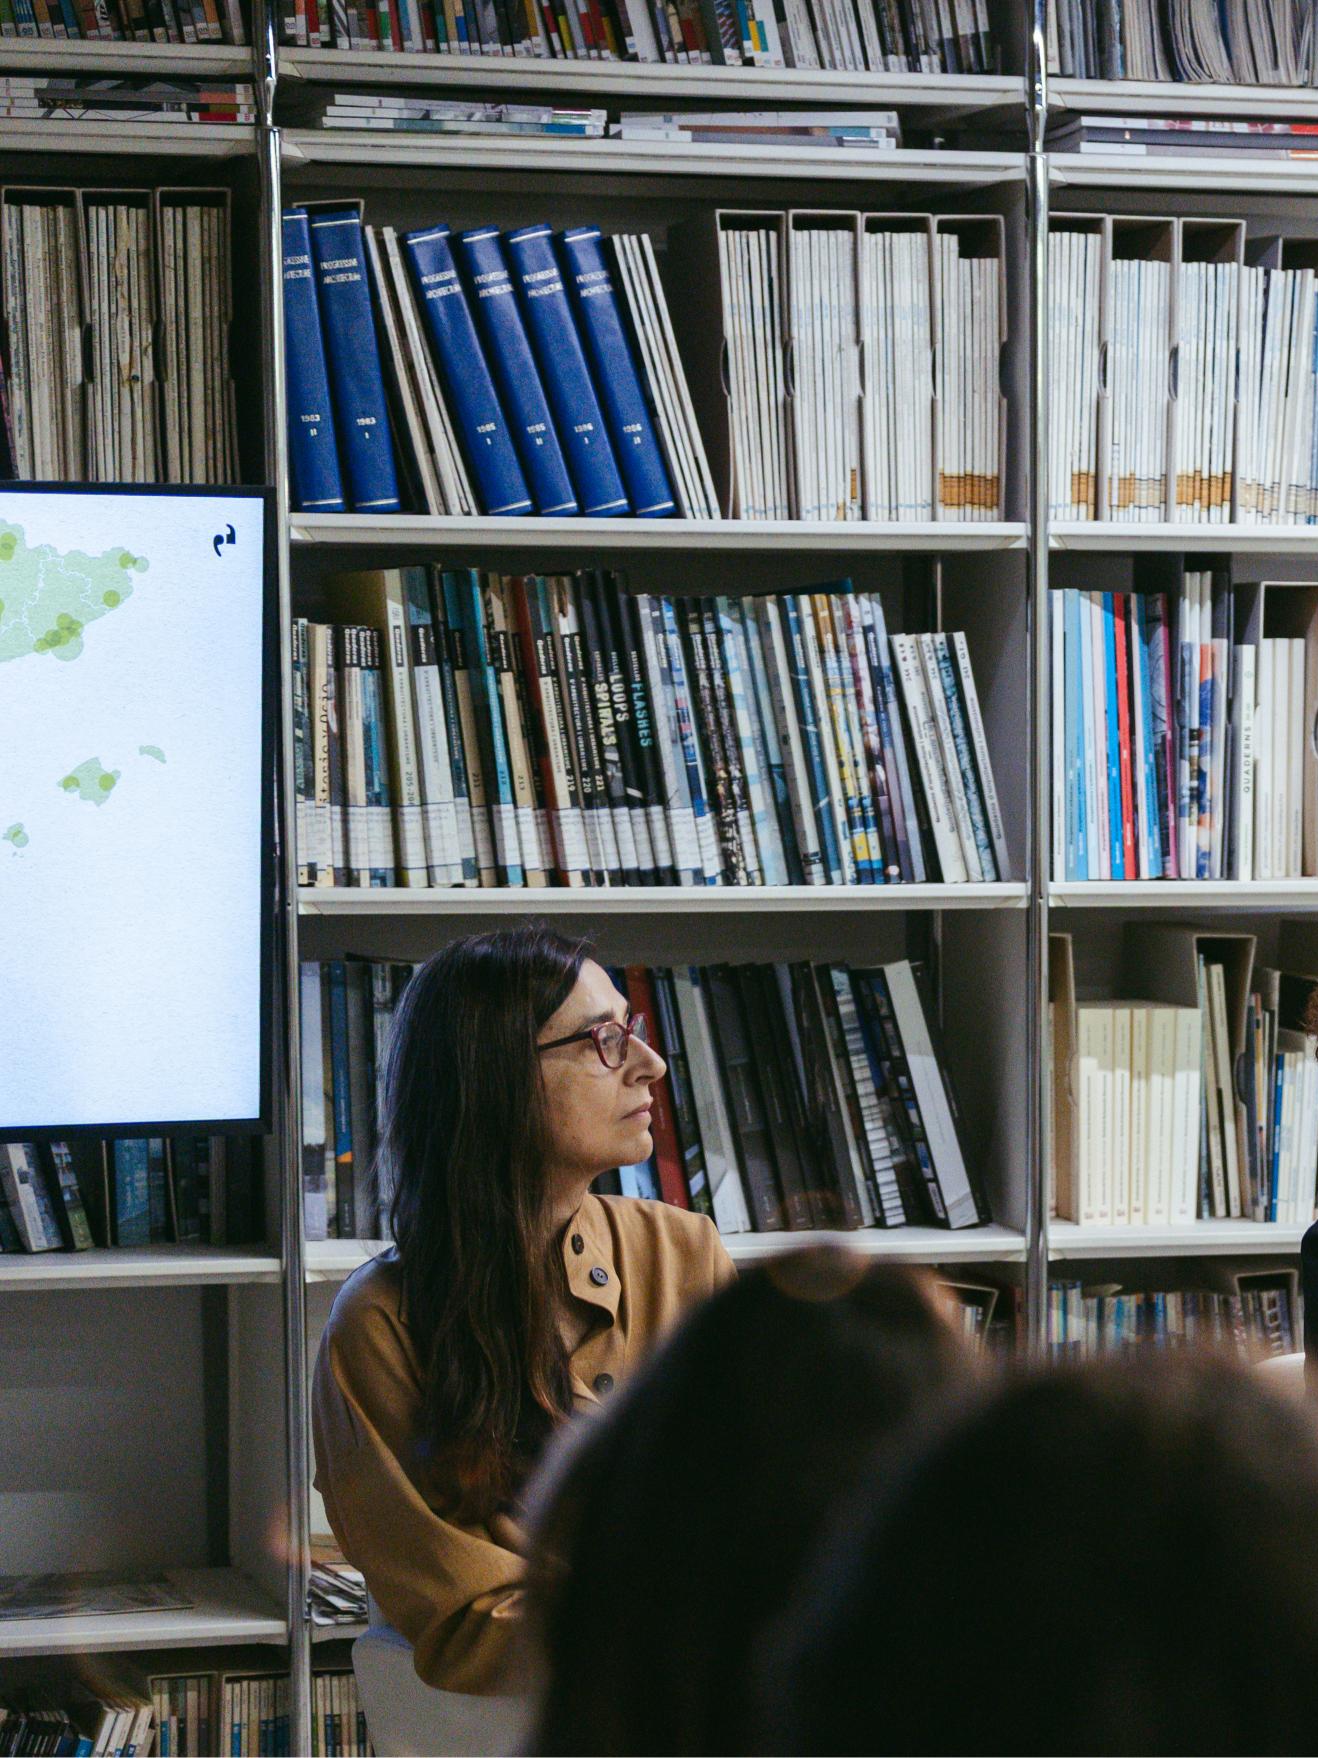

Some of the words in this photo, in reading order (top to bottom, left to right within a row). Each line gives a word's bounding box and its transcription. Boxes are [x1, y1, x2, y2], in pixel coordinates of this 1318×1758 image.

[300, 414, 321, 422] 1983
[356, 417, 376, 426] 1983
[418, 628, 428, 663] Quaderns
[536, 640, 547, 674] Quaderns
[564, 638, 574, 672] Quaderns
[582, 777, 592, 793] 220
[610, 674, 630, 722] LOOPS
[631, 683, 653, 747] FLASHES
[1242, 725, 1252, 794] QUADERNS
[595, 775, 604, 791] 221
